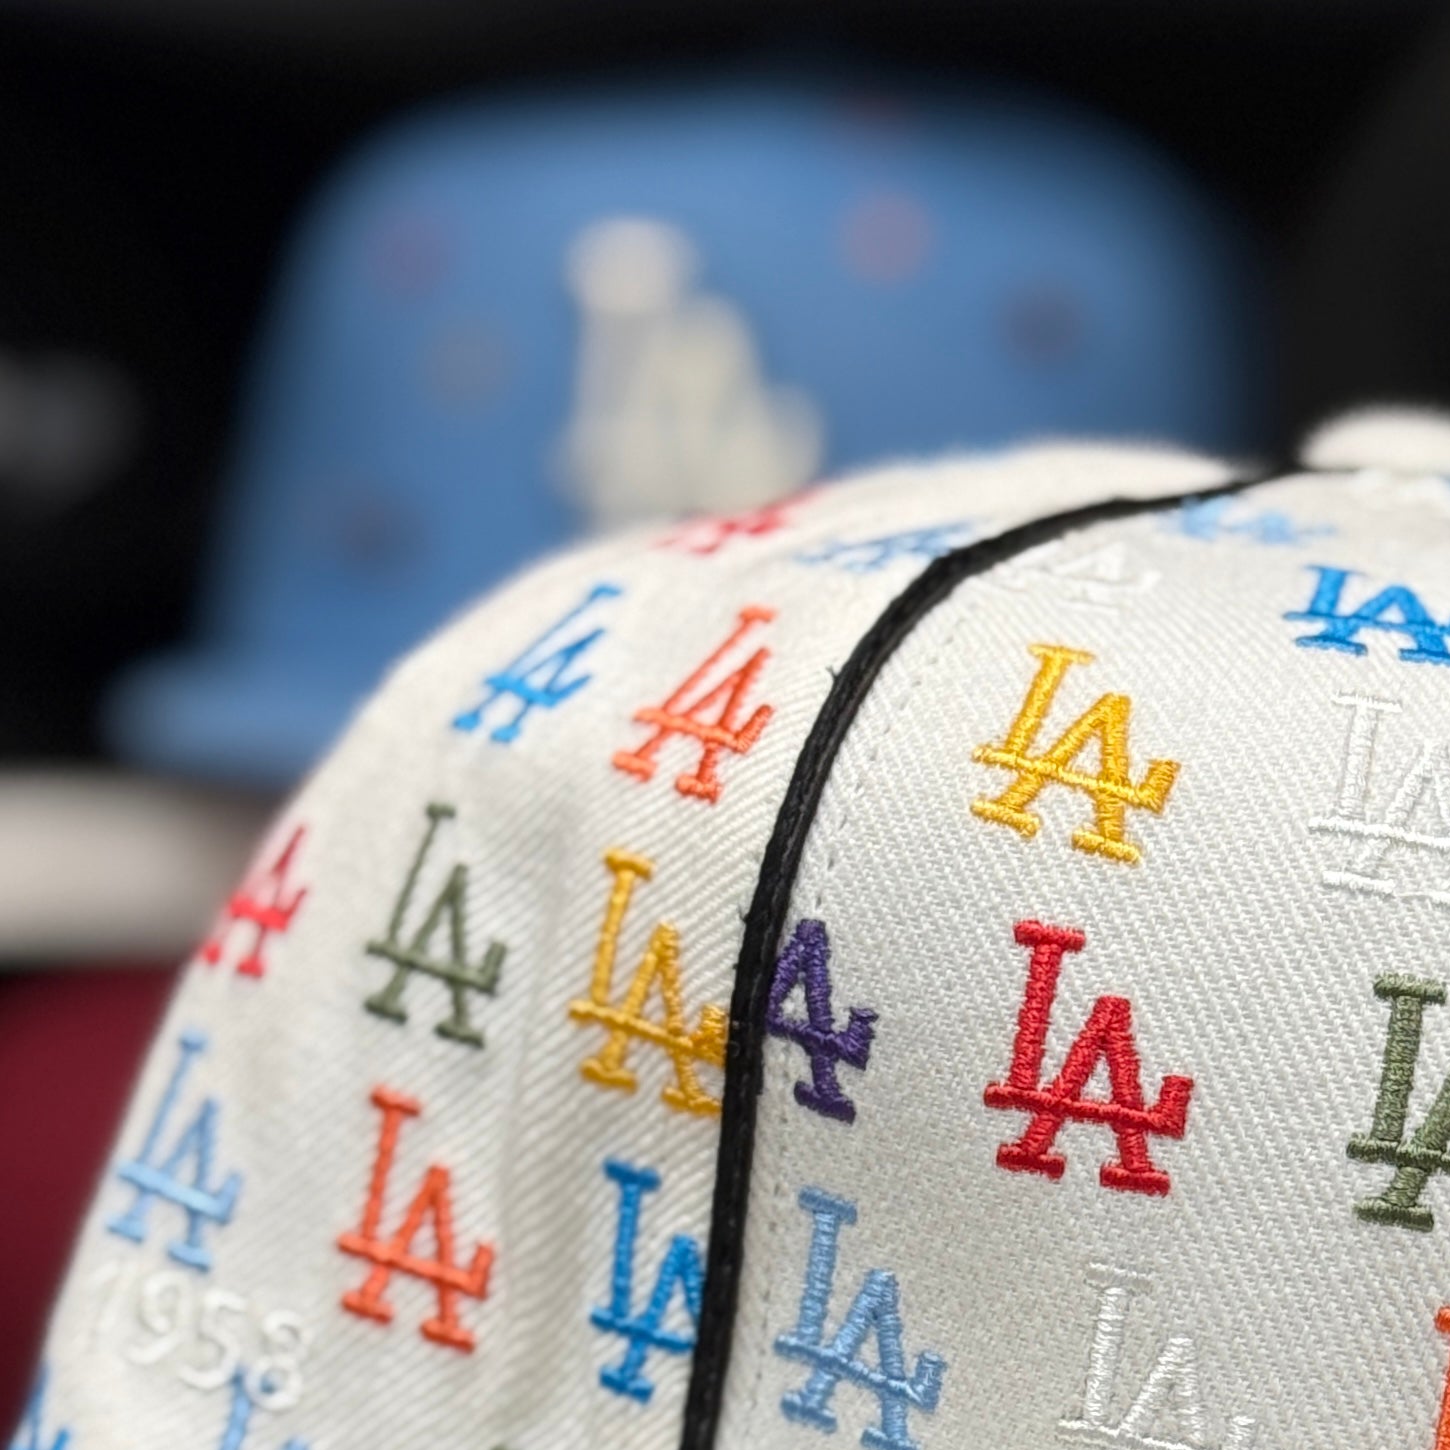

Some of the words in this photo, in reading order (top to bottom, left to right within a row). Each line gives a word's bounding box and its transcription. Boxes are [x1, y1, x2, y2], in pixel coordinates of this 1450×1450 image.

[452, 581, 623, 745] LA
[611, 605, 776, 806] LA
[970, 642, 1183, 866] LA
[363, 804, 507, 1049] LA
[568, 849, 728, 1119] LA
[764, 919, 878, 1123] A
[104, 1028, 243, 1271] LA
[983, 919, 1194, 1197] LA
[98, 1258, 312, 1412] 1958
[336, 1084, 497, 1355] LA
